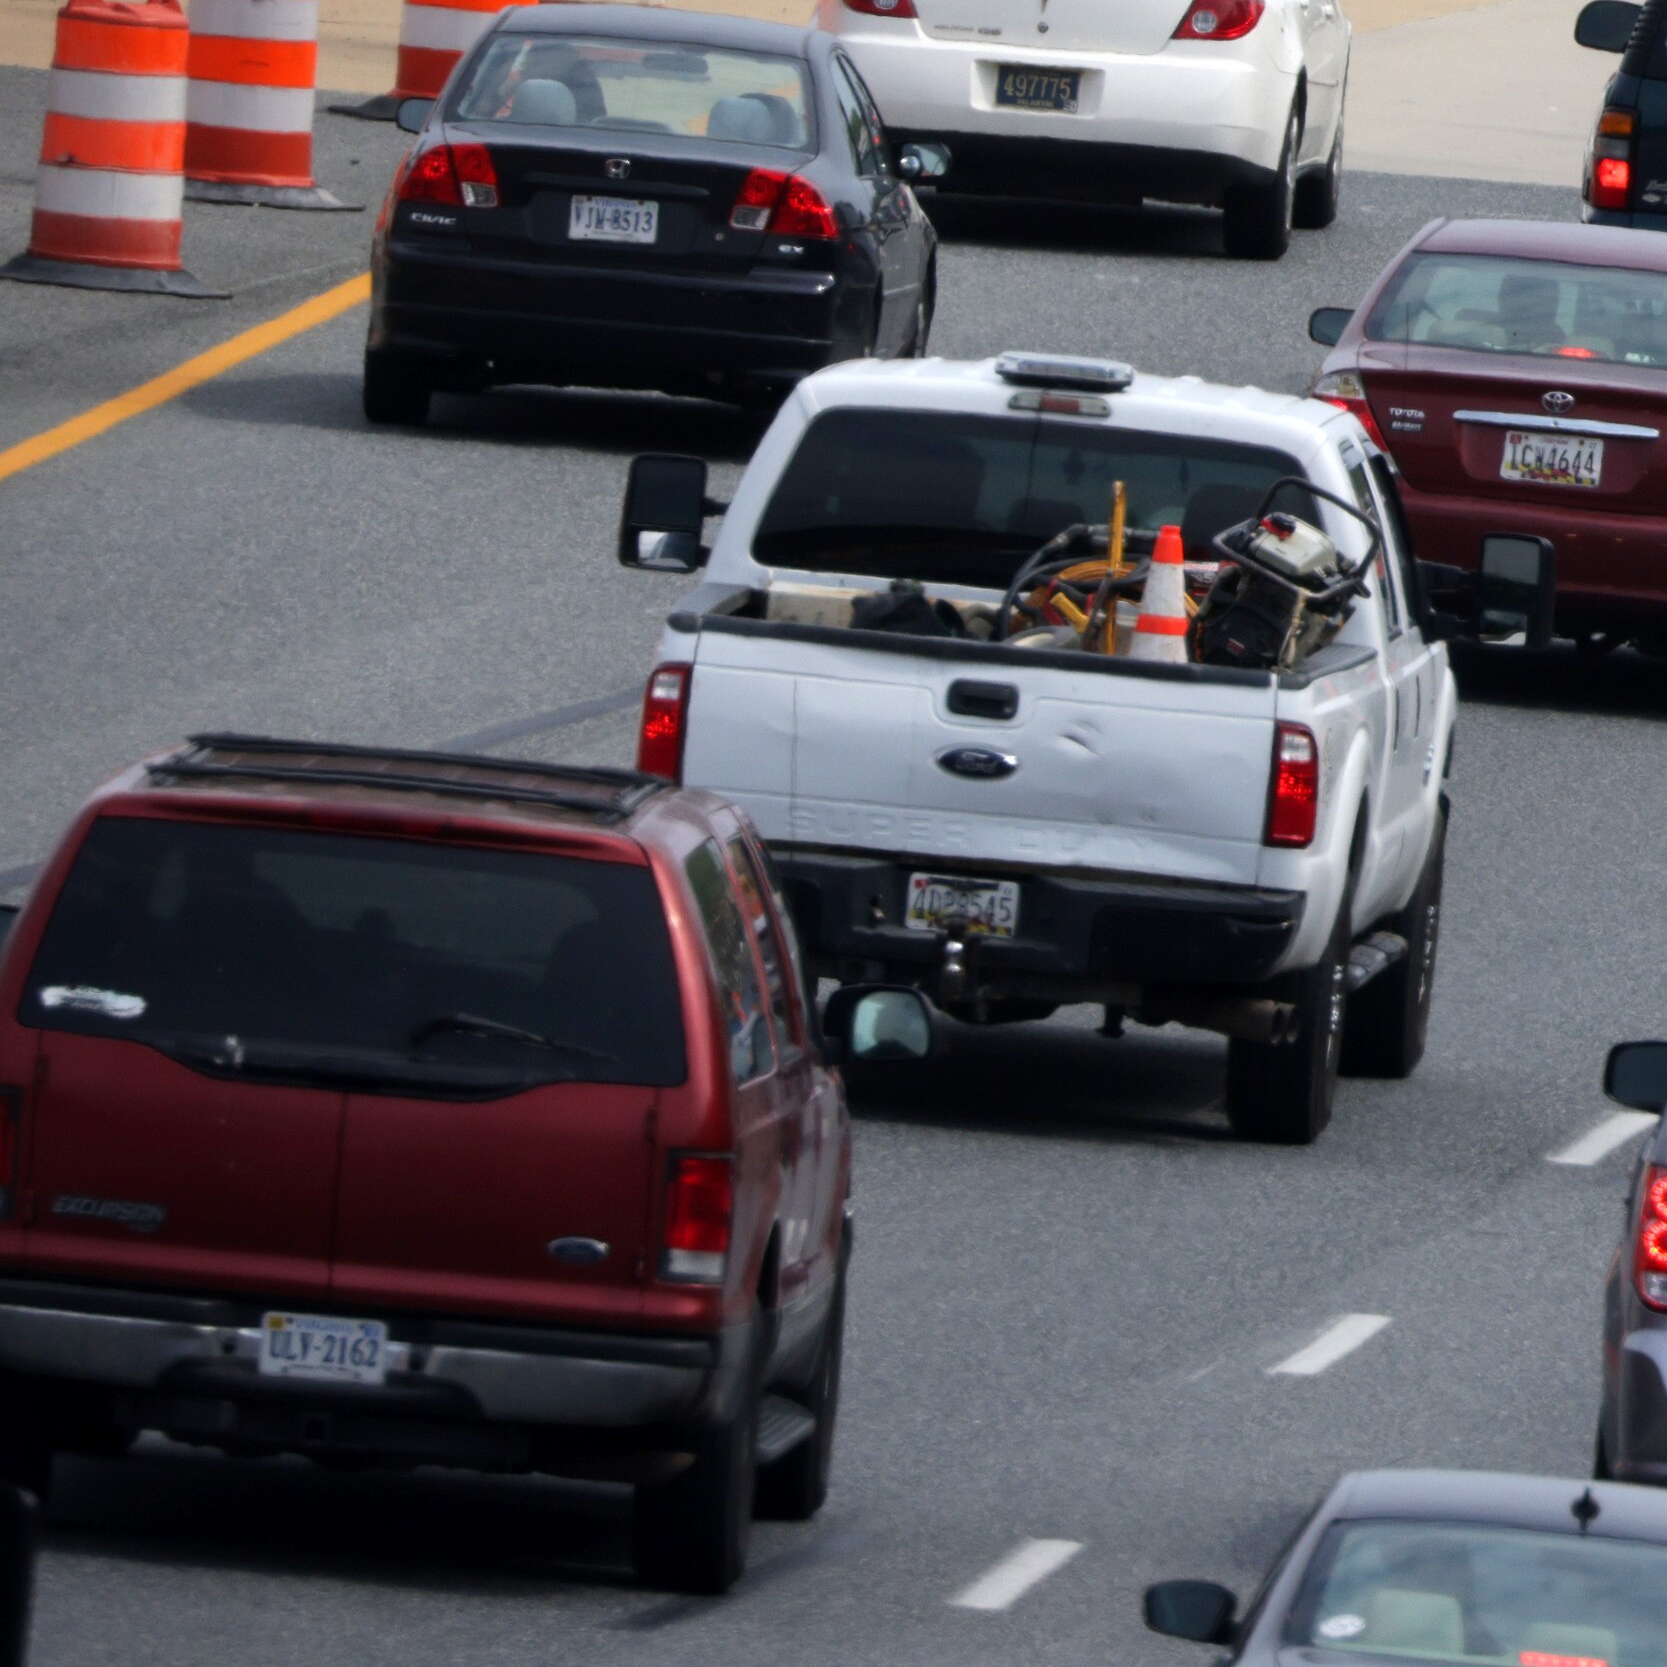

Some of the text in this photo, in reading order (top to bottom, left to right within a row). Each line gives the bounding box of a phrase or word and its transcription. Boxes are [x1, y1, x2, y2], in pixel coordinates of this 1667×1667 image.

[1003, 74, 1071, 100] 497775
[1389, 405, 1425, 417] TOYOTA
[786, 805, 973, 849] SUPER
